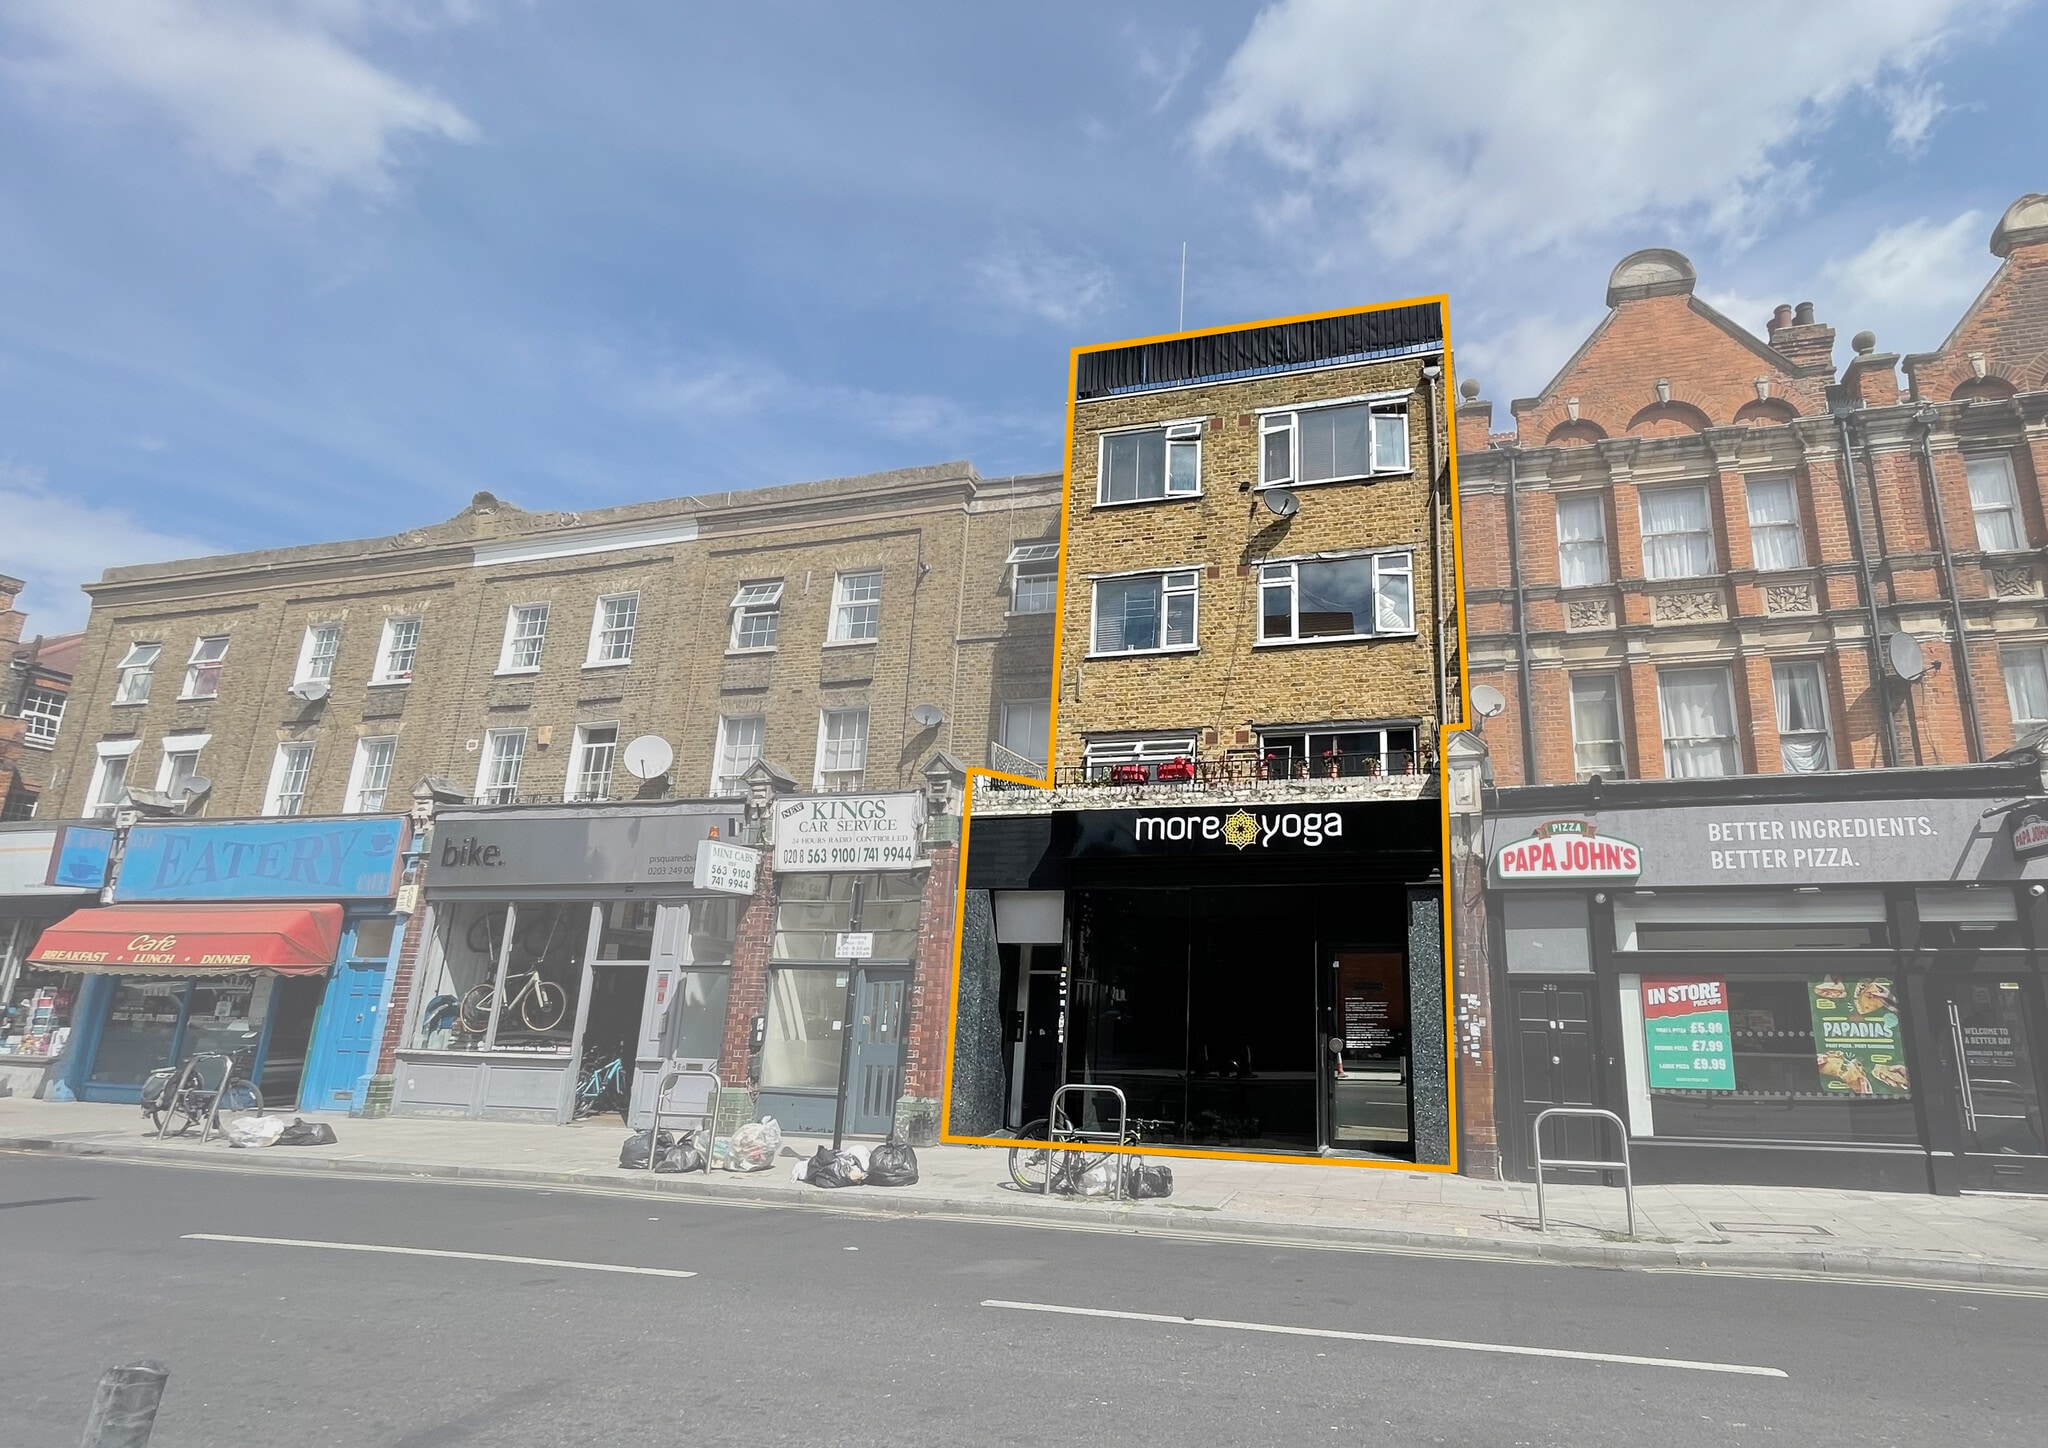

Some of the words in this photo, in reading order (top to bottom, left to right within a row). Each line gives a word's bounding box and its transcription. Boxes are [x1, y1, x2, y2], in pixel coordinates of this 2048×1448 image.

[811, 800, 886, 820] KINGS
[799, 821, 828, 833] CAR
[837, 819, 898, 832] SERVICE
[1135, 816, 1220, 841] more
[1261, 812, 1342, 847] yoga
[1551, 822, 1581, 832] PIZZA
[1708, 820, 1785, 842] BETTER
[1790, 816, 1938, 840] INGREDIENTS.
[856, 835, 908, 843] CONTROLLED
[441, 836, 505, 867] bike.
[712, 847, 732, 859] MINI
[734, 851, 754, 863] CABS
[783, 849, 797, 864] 020
[807, 848, 827, 864] 563
[883, 846, 911, 862] 9944
[1503, 842, 1557, 872] PAPA
[1561, 841, 1637, 871] JOHN'S
[1710, 849, 1788, 870] BETTER
[1793, 847, 1860, 868] PIZZA.
[153, 827, 363, 892] EATERY
[648, 866, 666, 875] 0203
[668, 866, 682, 875] 249
[711, 864, 728, 876] 563
[732, 868, 751, 879] 9100
[711, 876, 724, 886] 741
[728, 878, 748, 890] 9944
[127, 934, 177, 951] Cafe
[40, 950, 109, 962] BREAKFAST
[132, 953, 176, 964] LUNCH
[200, 954, 251, 965] DINNER
[1647, 988, 1666, 1005] IN
[1667, 982, 1721, 1003] STORE
[1693, 998, 1722, 1007] PICK-UPS
[1690, 1022, 1723, 1034] £5.99
[1823, 1022, 1893, 1038] PAPADIAS
[1964, 1027, 1998, 1035] WELCOME
[1692, 1040, 1723, 1052] £7.99
[1970, 1036, 1997, 1045] BETTER
[1998, 1037, 2011, 1045] DAY
[1693, 1058, 1726, 1070] £9.99
